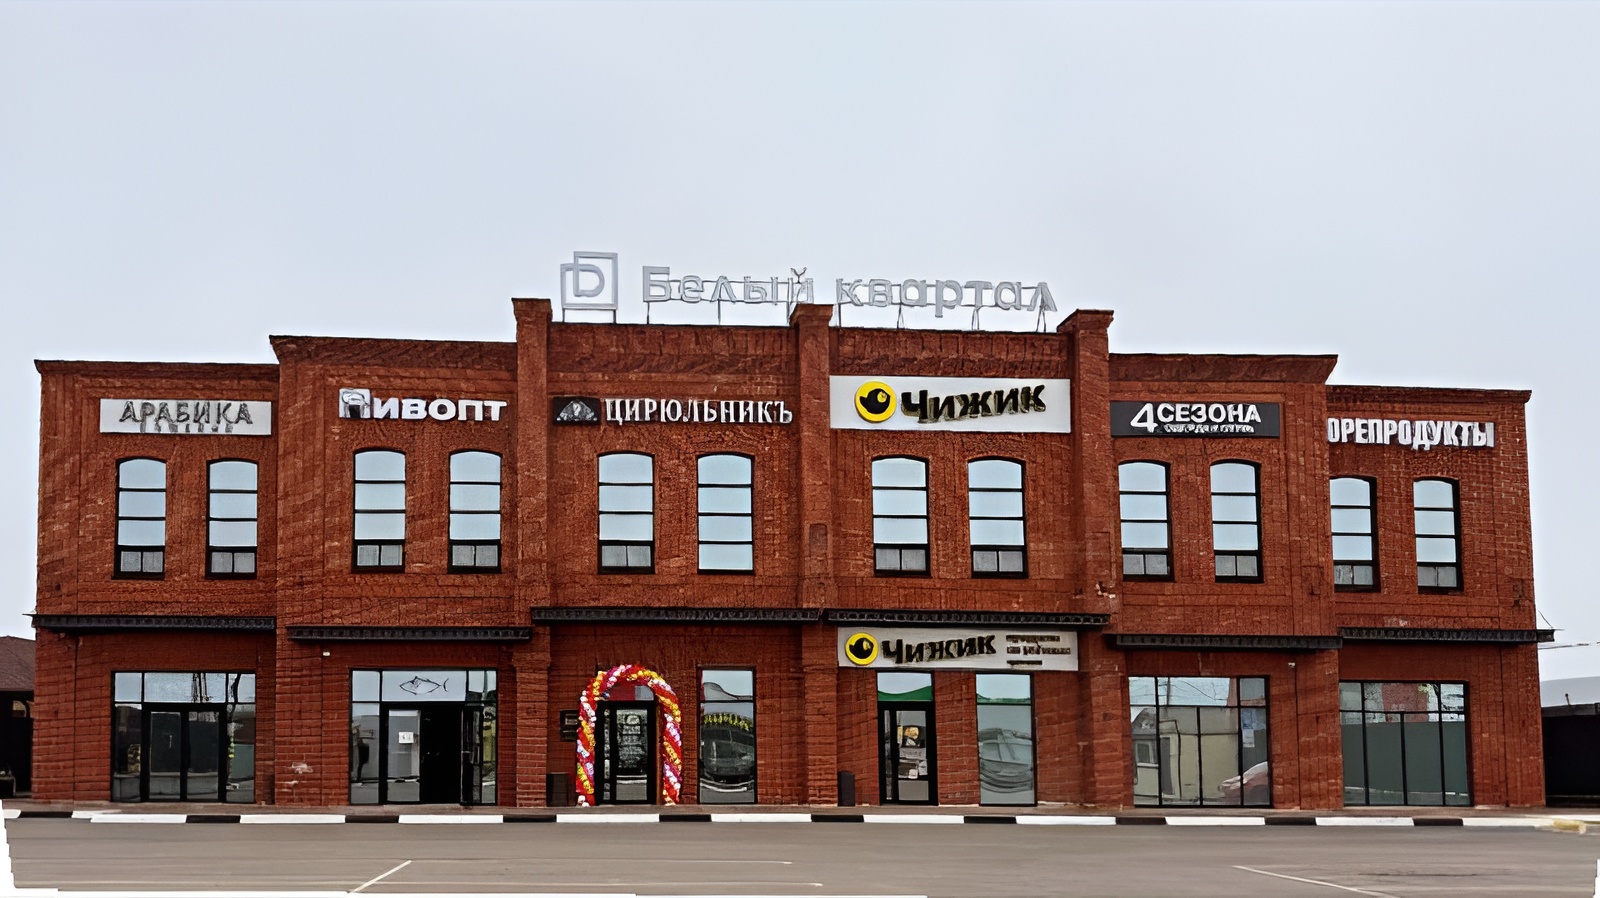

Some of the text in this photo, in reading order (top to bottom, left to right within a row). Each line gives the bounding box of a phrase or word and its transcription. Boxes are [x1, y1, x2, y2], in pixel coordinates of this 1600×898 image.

[642, 265, 1058, 318] Белый квартал
[118, 400, 254, 425] АРАБИКА
[605, 398, 794, 425] ЦИРЮЛЬНИКЪ
[1130, 402, 1158, 433] 4
[1157, 402, 1262, 424] СЕЗОНА
[1327, 417, 1495, 450] ОРЕПРОДУКТЫ
